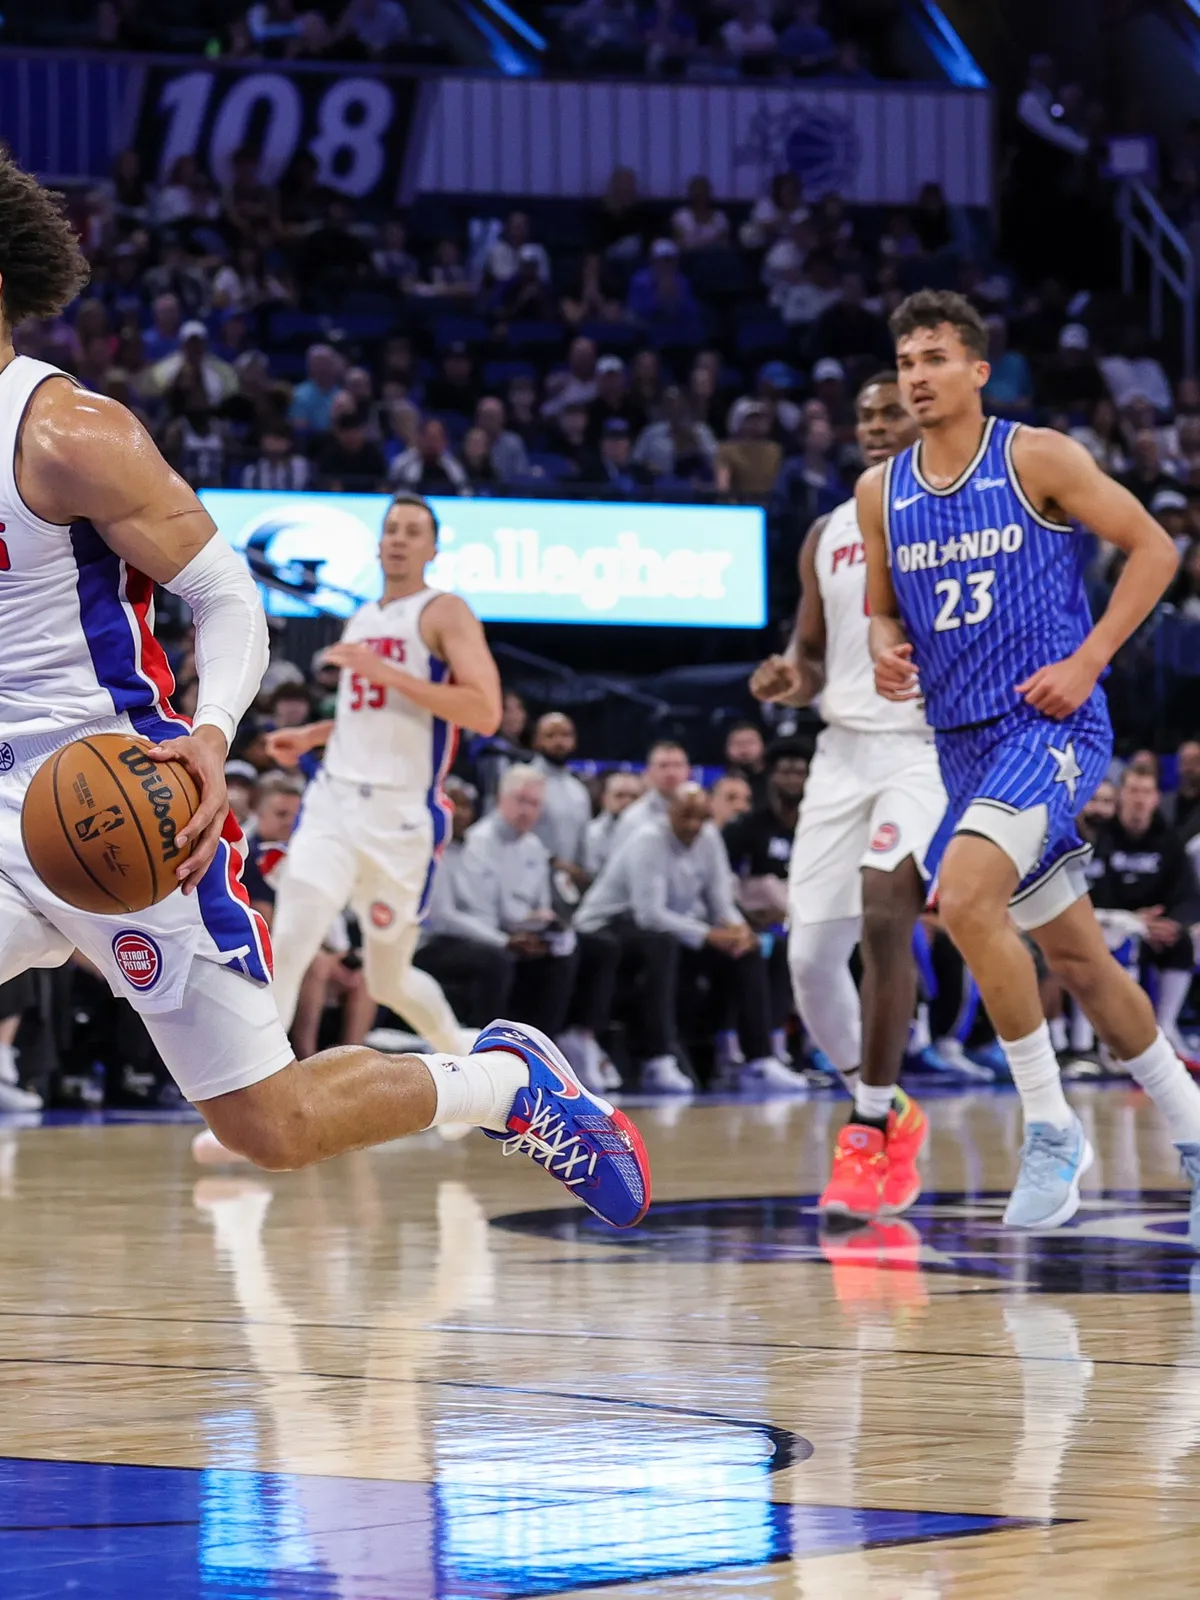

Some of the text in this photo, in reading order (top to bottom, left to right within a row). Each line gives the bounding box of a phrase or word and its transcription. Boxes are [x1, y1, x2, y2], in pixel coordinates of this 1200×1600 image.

[157, 71, 393, 198] 108
[932, 569, 997, 633] 23
[351, 672, 386, 713] 55
[117, 745, 182, 864] Wilson
[120, 950, 149, 961] DETROIT
[122, 960, 152, 971] PISTONS
